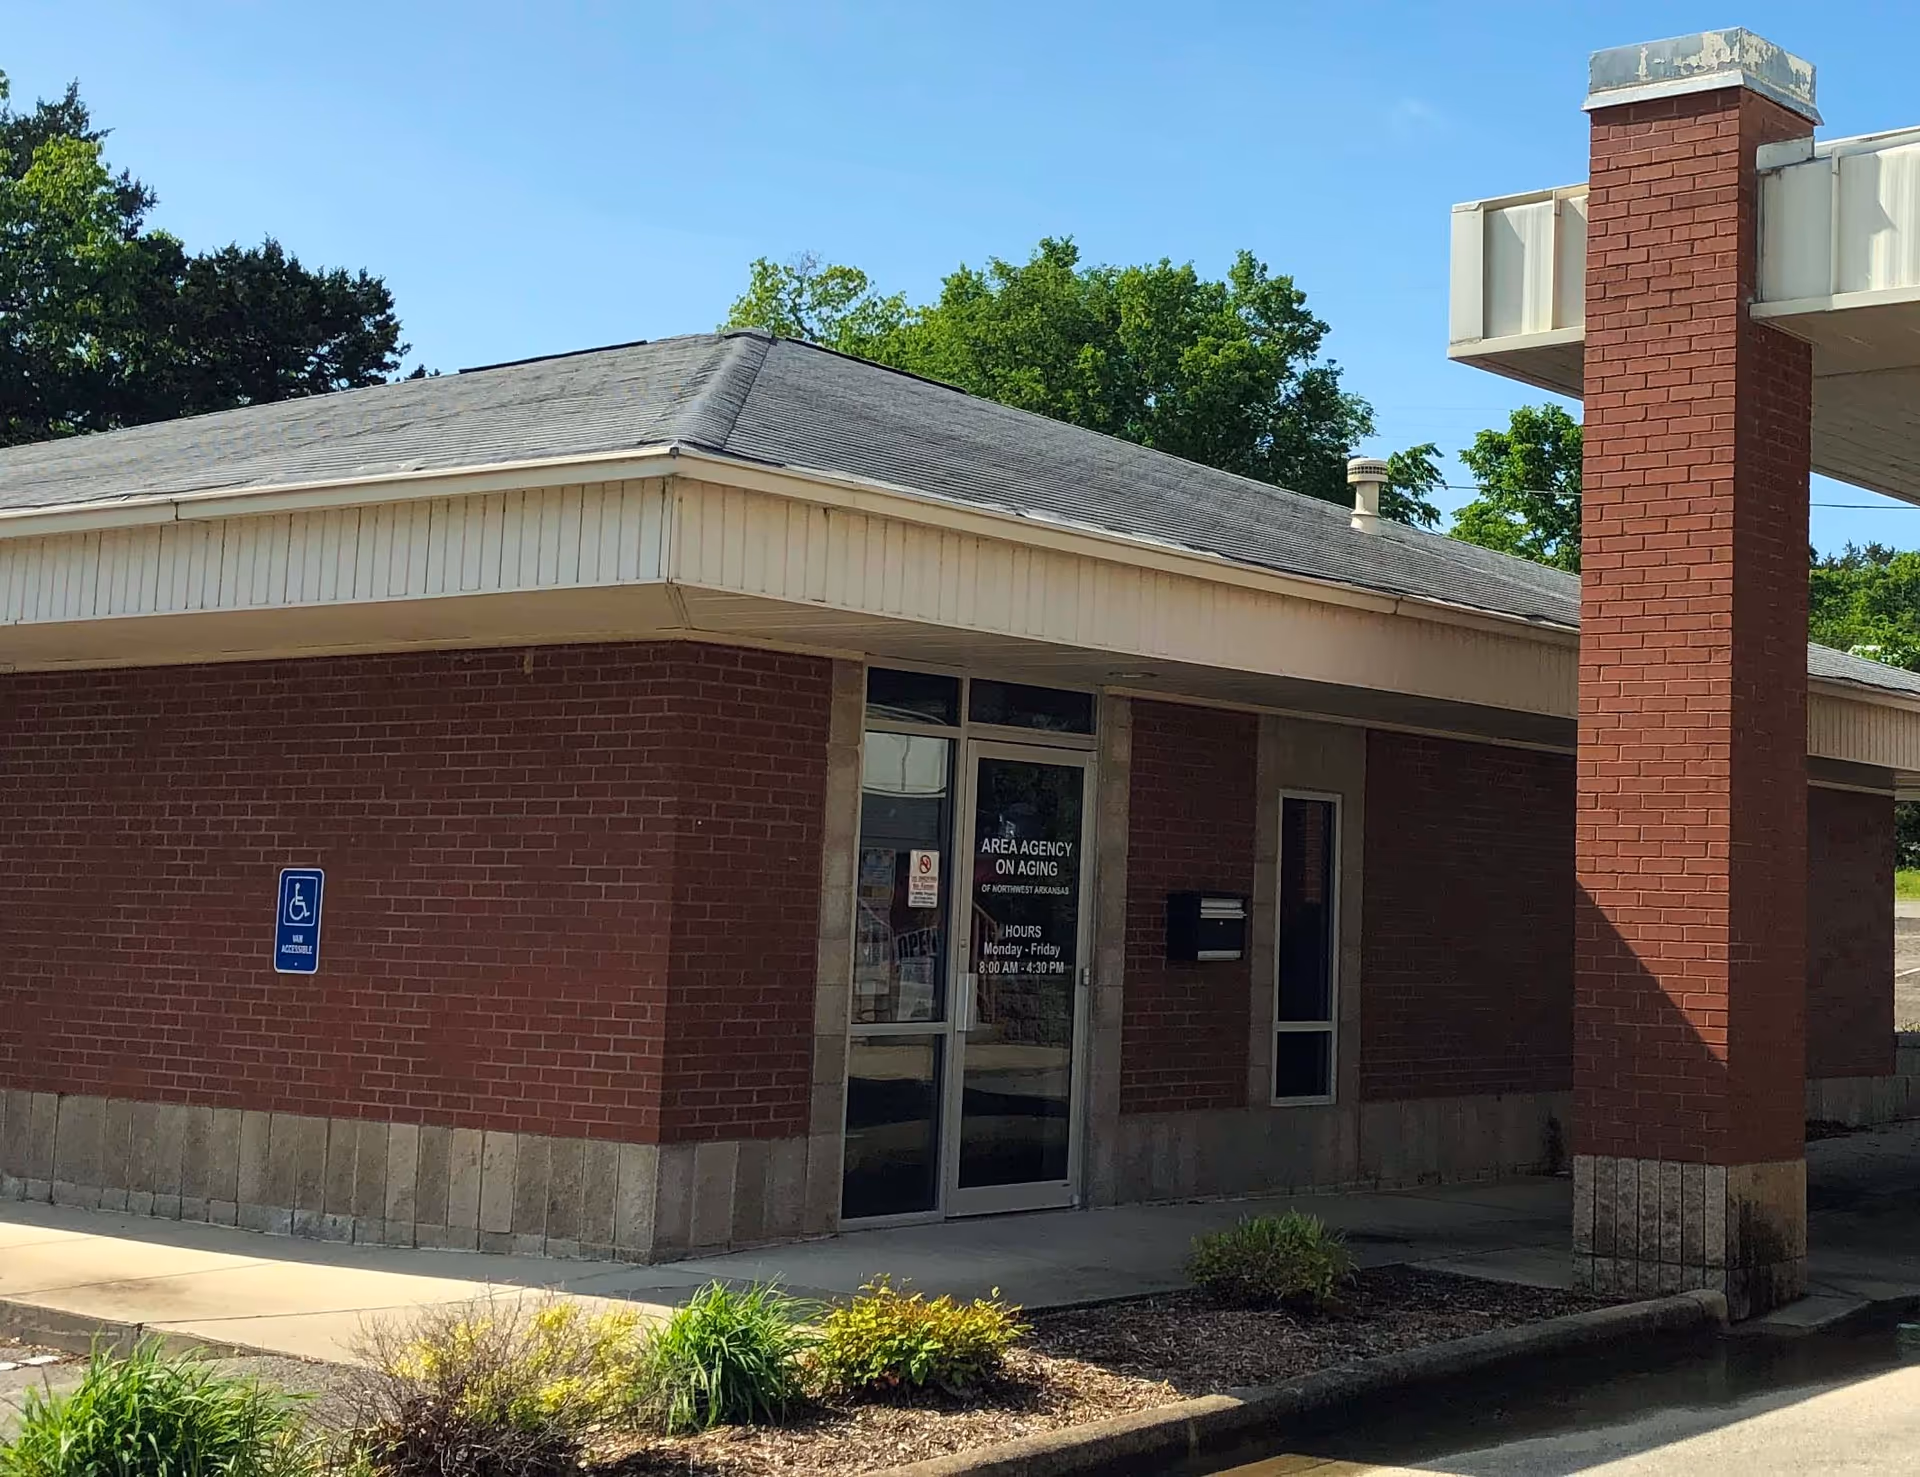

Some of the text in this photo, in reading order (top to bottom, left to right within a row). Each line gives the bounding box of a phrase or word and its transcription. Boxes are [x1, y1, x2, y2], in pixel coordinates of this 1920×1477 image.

[981, 838, 1072, 856] AREA AGENCY
[995, 859, 1058, 876] ON AGING
[981, 884, 1069, 895] OF NORTHWEST ARKANSAS
[1005, 924, 1042, 938] HOURS
[281, 944, 313, 955] ACCESSIBLE
[984, 941, 1023, 958] Monday
[1031, 942, 1061, 958] Friday
[979, 961, 1000, 974] 8:00
[1001, 961, 1018, 974] AM
[1026, 961, 1047, 974] 4:30
[1049, 961, 1064, 974] PM
